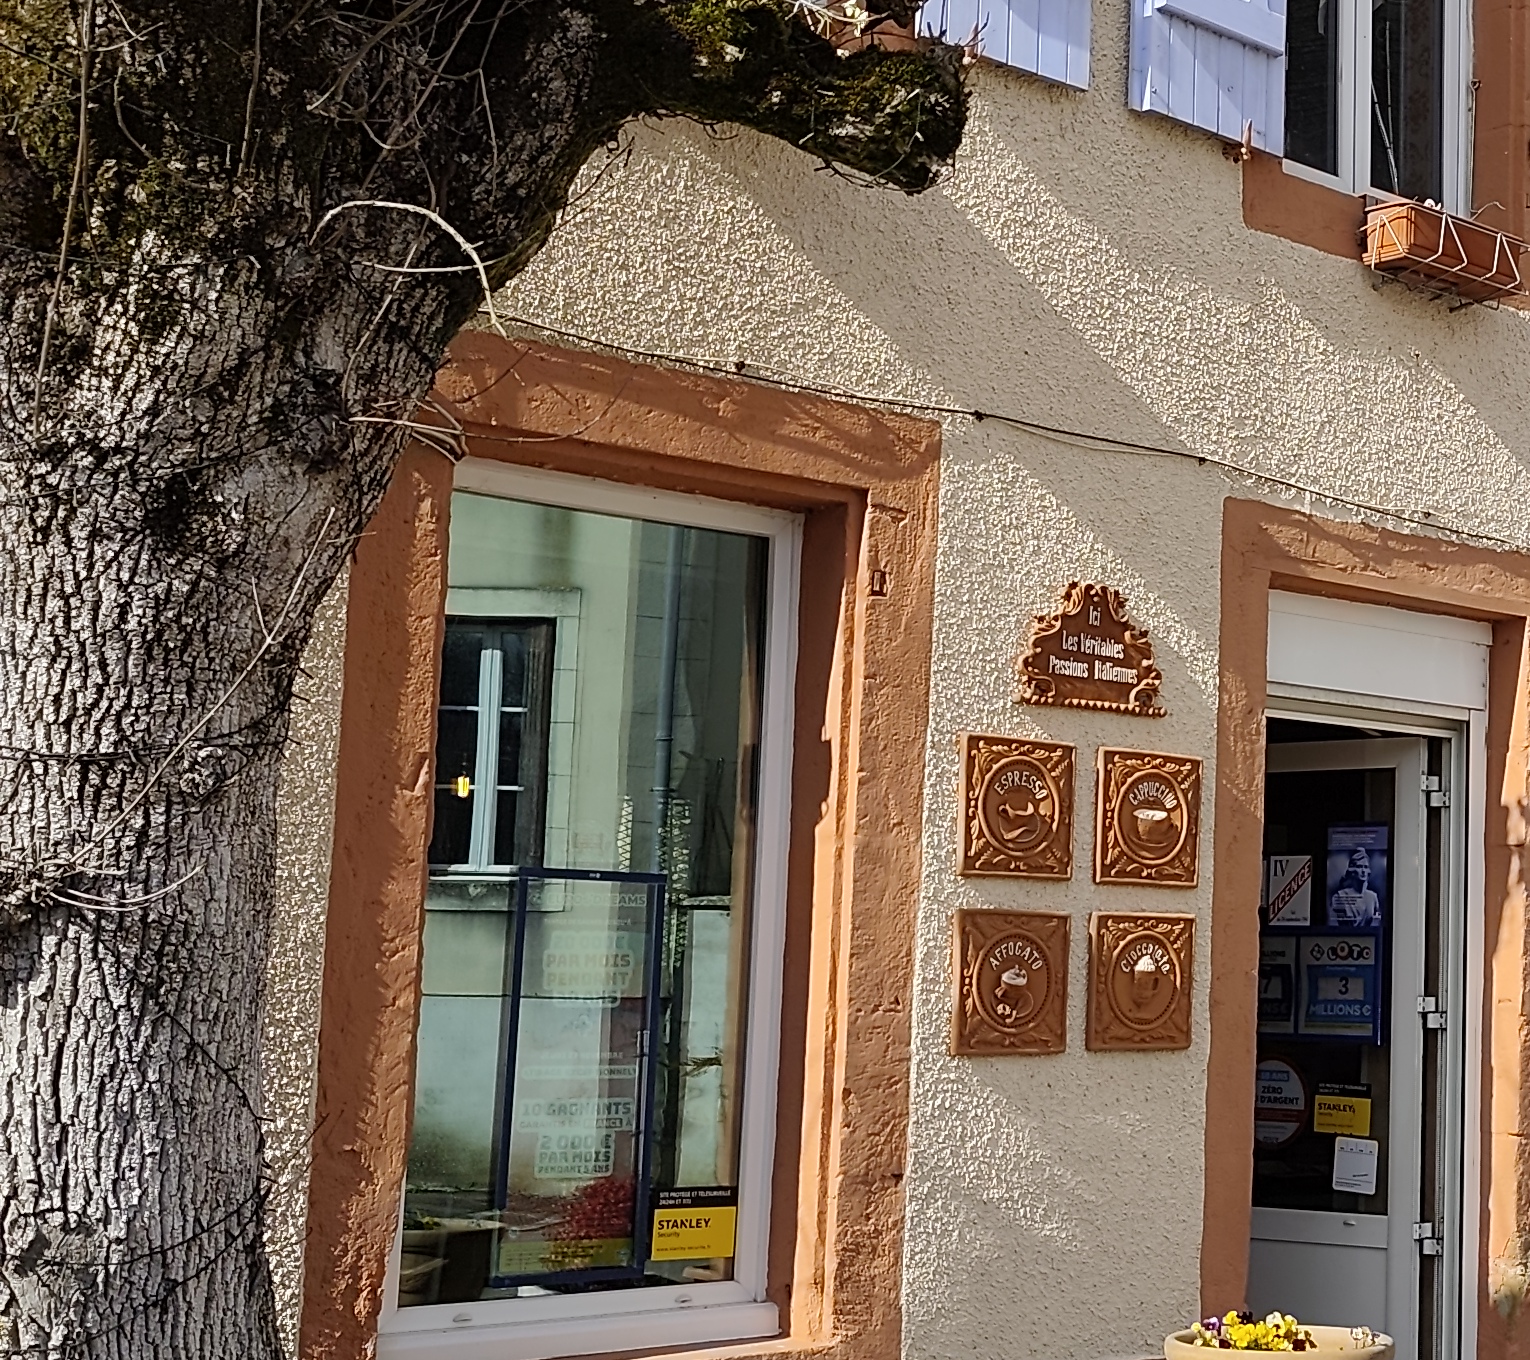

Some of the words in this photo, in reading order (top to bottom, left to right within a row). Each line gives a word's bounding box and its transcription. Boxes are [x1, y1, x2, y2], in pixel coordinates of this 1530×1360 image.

[1088, 605, 1101, 627] Ici
[1062, 630, 1078, 652] Les
[1080, 632, 1125, 660] Véritables
[1048, 654, 1089, 678] Passions
[1094, 660, 1138, 685] Italiennes
[993, 770, 1048, 800] ESPRESSO
[1128, 781, 1178, 809] CAPPUCCINO
[1273, 859, 1289, 877] IV
[1269, 861, 1312, 918] LICENCE
[989, 941, 1043, 971] AFFOGATO
[1326, 940, 1372, 961] LOTO
[546, 953, 578, 969] PAR
[584, 953, 631, 969] MOIS
[547, 971, 630, 987] PENDANT
[1338, 976, 1349, 995] 3
[1261, 1084, 1283, 1095] ZÉRO
[545, 1102, 631, 1116] GAGNANTS
[1259, 1096, 1300, 1106] D'ARGENT
[583, 1119, 622, 1129] ANCE
[539, 1151, 569, 1163] PAR
[572, 1150, 611, 1163] MOIS
[657, 1218, 711, 1230] STANLEY
